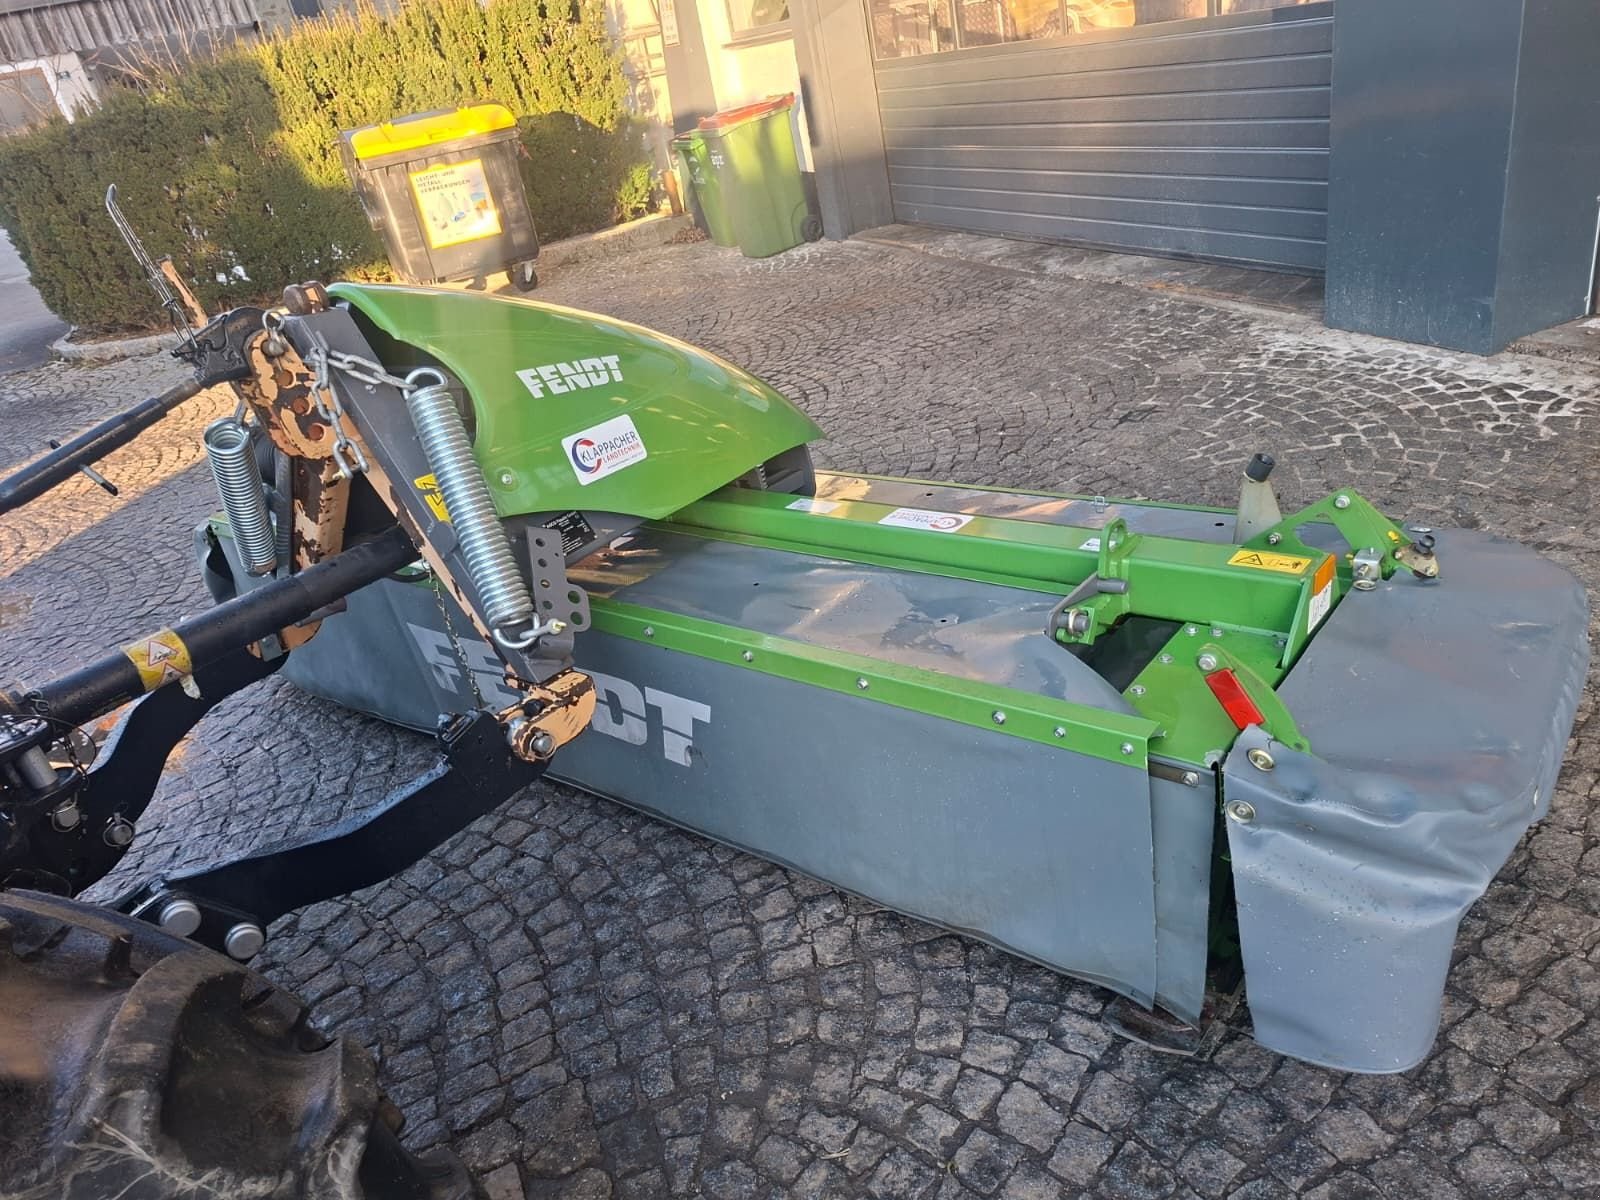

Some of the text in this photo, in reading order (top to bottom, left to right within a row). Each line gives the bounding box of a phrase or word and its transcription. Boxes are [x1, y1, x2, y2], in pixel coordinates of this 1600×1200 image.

[515, 354, 624, 399] FENDT
[581, 431, 638, 463] KLAPPACHER
[406, 622, 711, 767] FEDT
